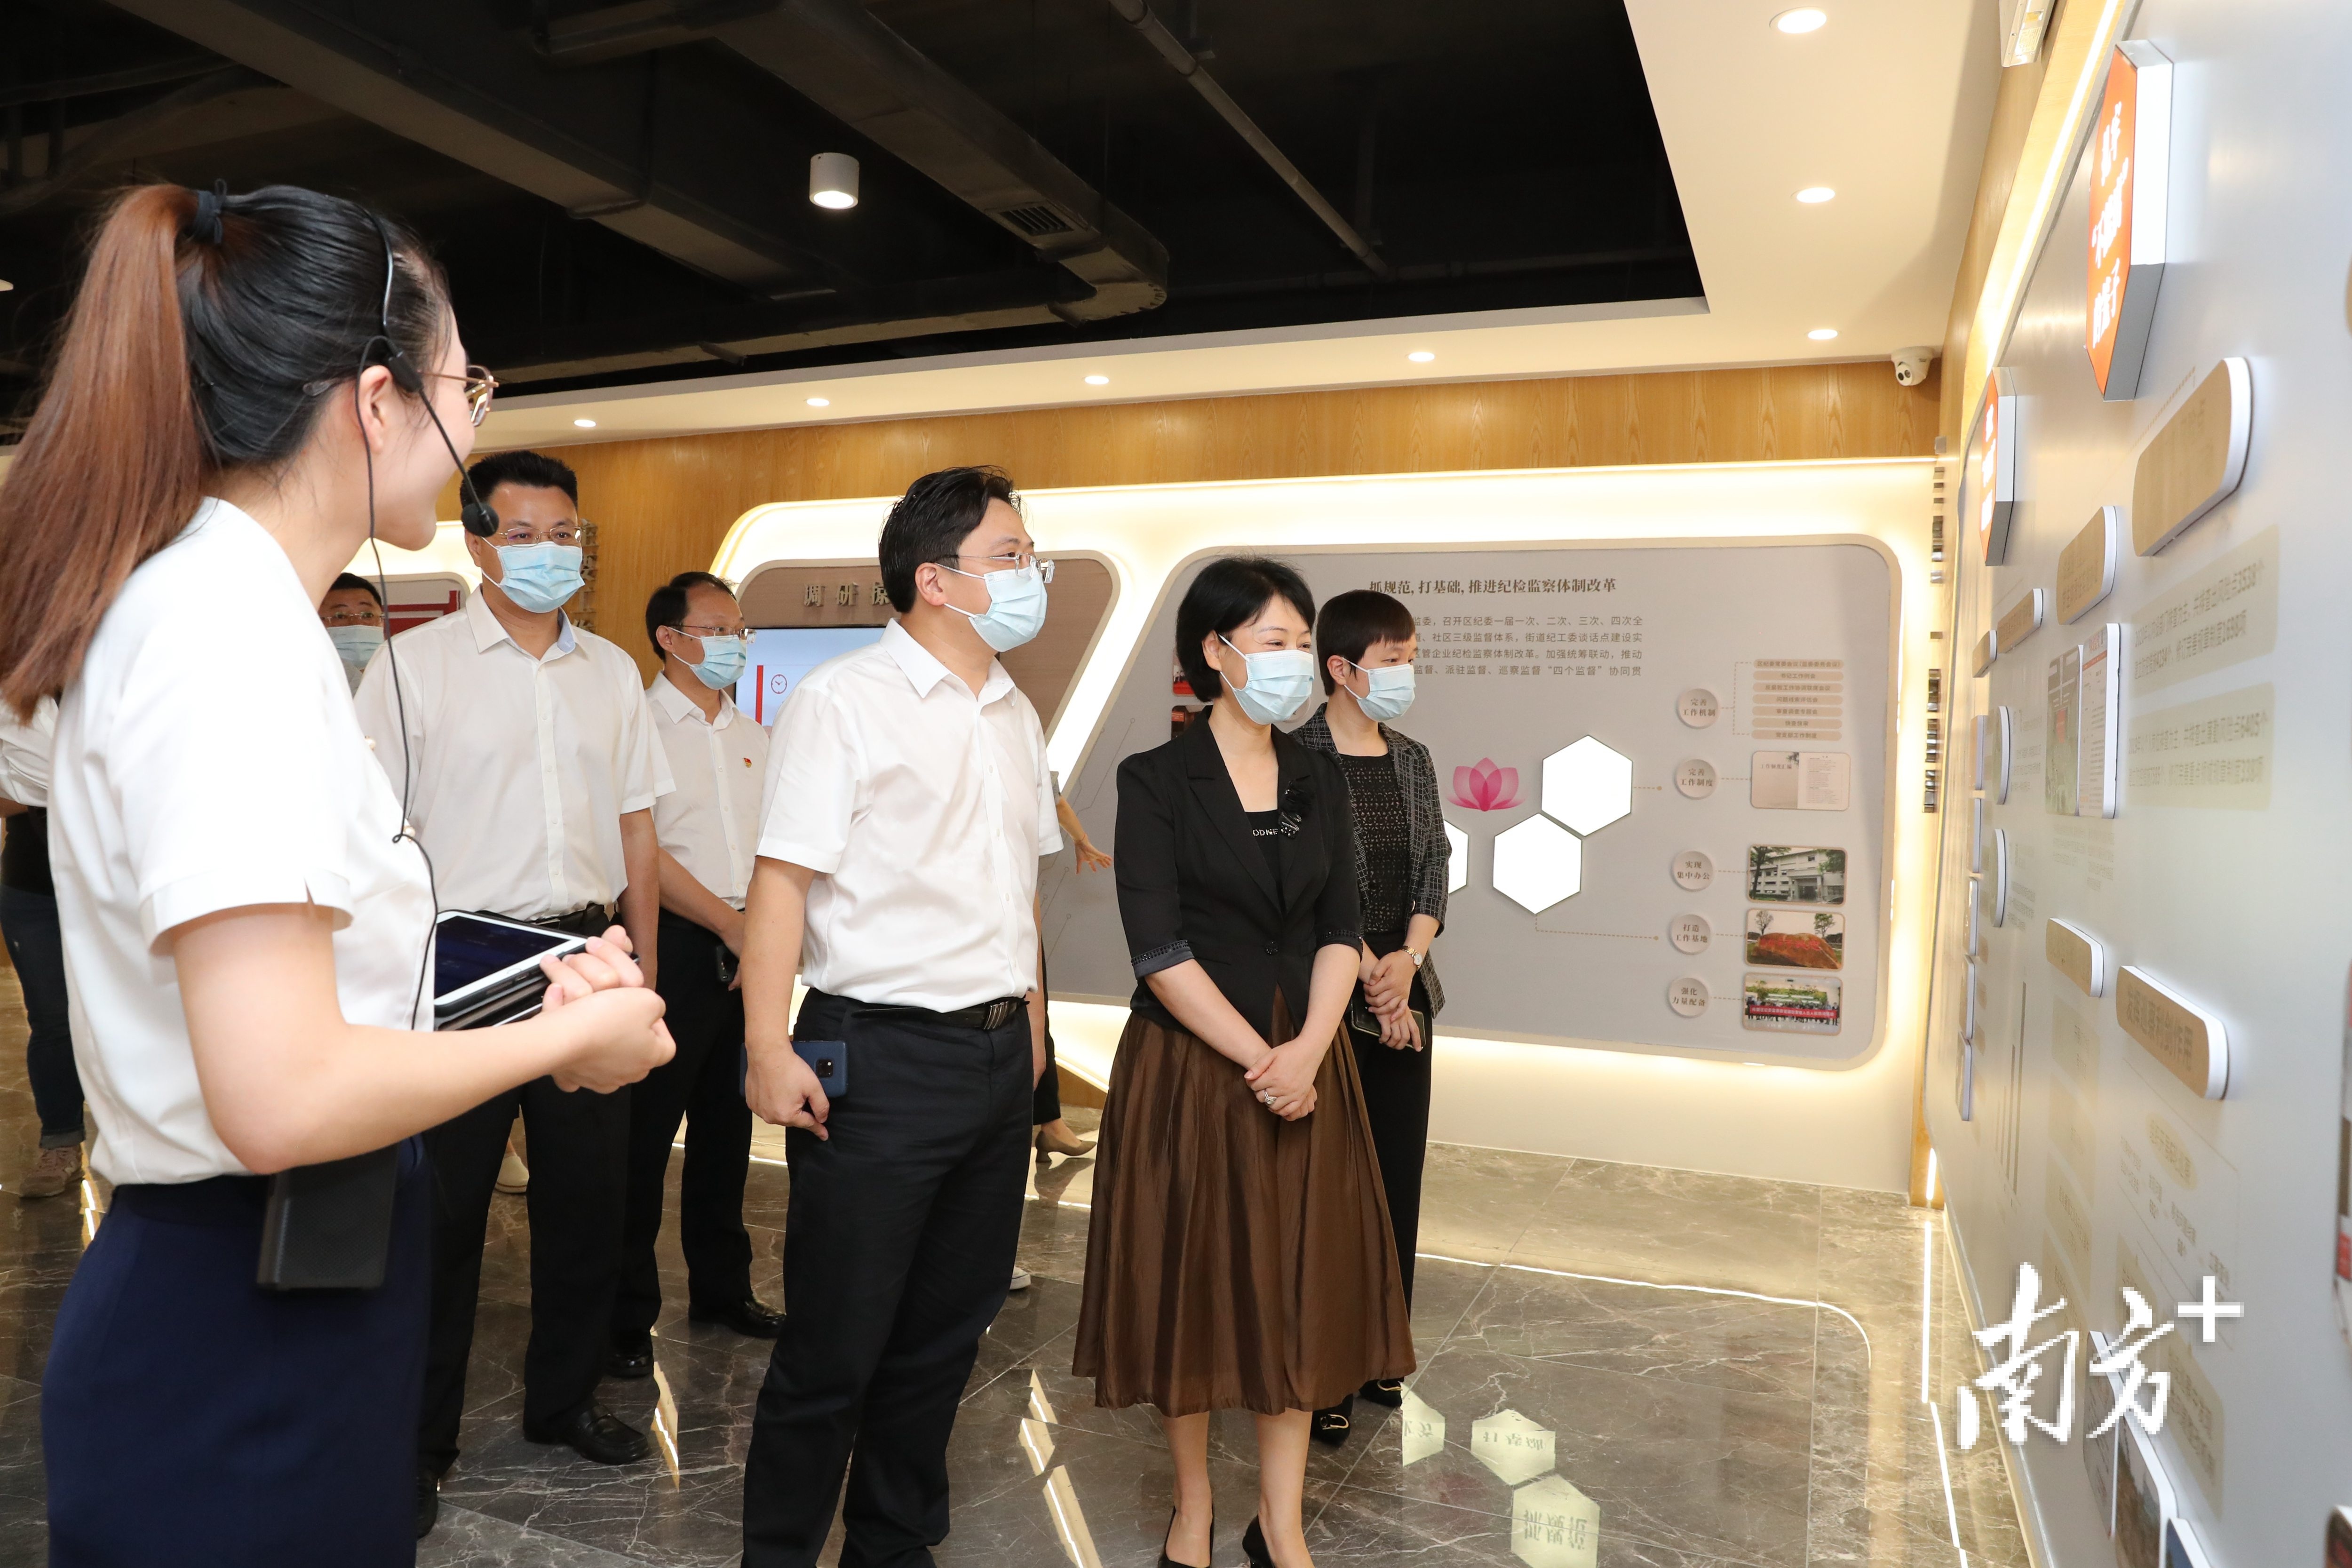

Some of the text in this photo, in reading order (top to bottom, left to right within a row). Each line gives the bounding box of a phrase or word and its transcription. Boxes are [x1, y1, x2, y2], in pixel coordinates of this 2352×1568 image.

[1683, 708, 1716, 717] 工作机制
[1680, 778, 1714, 787] 工作制度
[1677, 872, 1710, 880] 集中办公
[1683, 924, 1700, 932] 打造
[1675, 934, 1708, 943] 工作基地
[1672, 997, 1706, 1007] 力量配备
